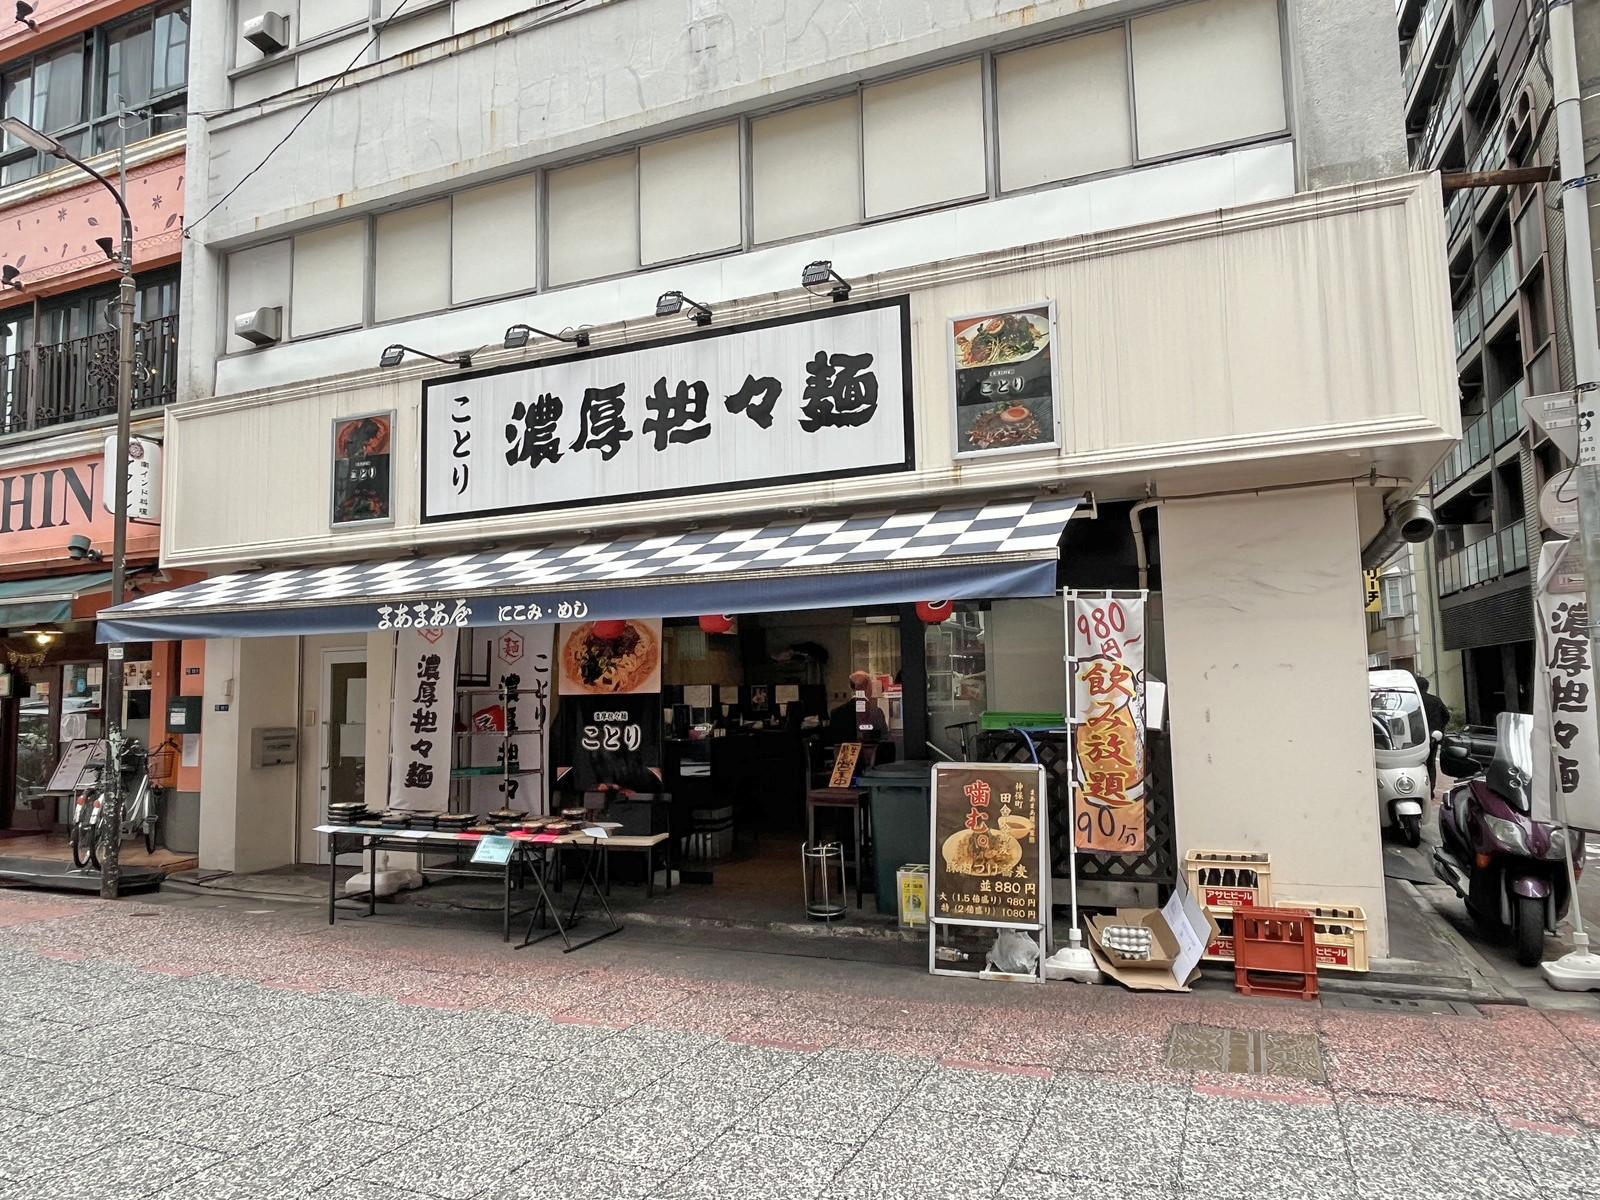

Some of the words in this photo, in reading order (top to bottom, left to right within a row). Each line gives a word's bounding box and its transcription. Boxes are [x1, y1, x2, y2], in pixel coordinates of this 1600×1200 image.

[505, 350, 879, 469] 濃厚担々麺
[980, 376, 1025, 396] ことり
[451, 396, 472, 496] ことり
[0, 463, 99, 533] HIN
[377, 599, 472, 630] まあまあ屋
[497, 600, 589, 622] にこみ・めし
[502, 636, 520, 658] 麺
[533, 654, 550, 728] ことり
[403, 654, 442, 790] 濃厚担々麺
[582, 724, 641, 751] ことり
[1082, 662, 1136, 808] 飲み放題
[1014, 782, 1025, 809] 神保町
[1206, 890, 1253, 900] アサヒビール
